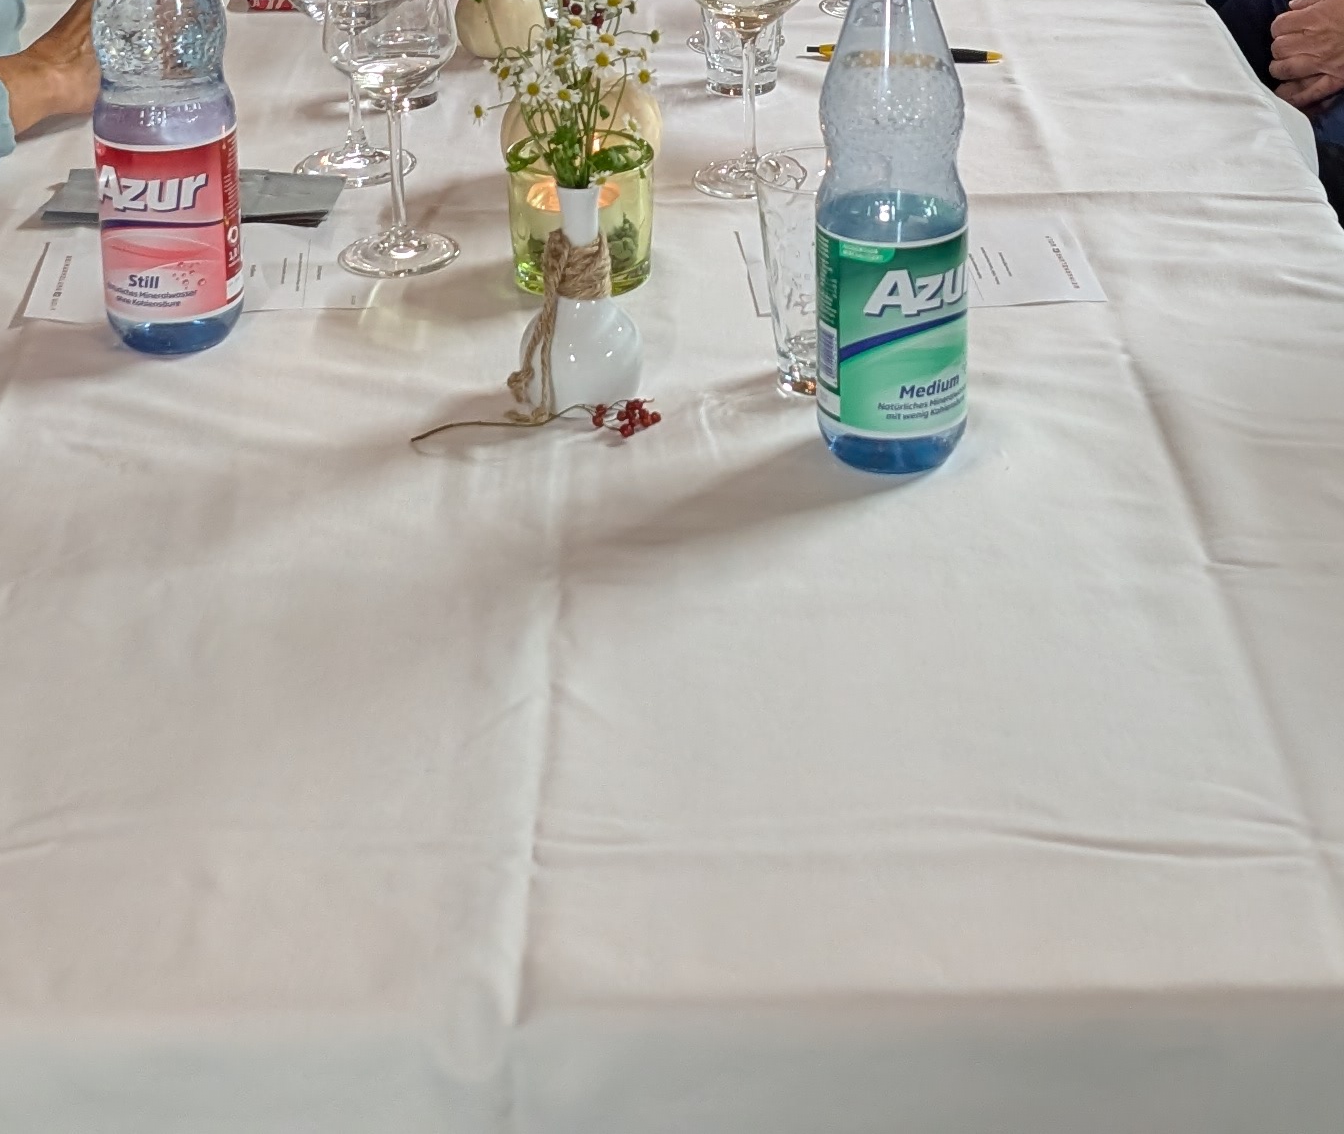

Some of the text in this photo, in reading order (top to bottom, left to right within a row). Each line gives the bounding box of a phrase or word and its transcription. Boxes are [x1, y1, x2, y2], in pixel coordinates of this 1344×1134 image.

[99, 164, 207, 213] Azur
[128, 273, 160, 290] Still
[863, 261, 968, 318] Azu
[899, 373, 960, 400] Medium
[878, 400, 928, 412] Natürliches
